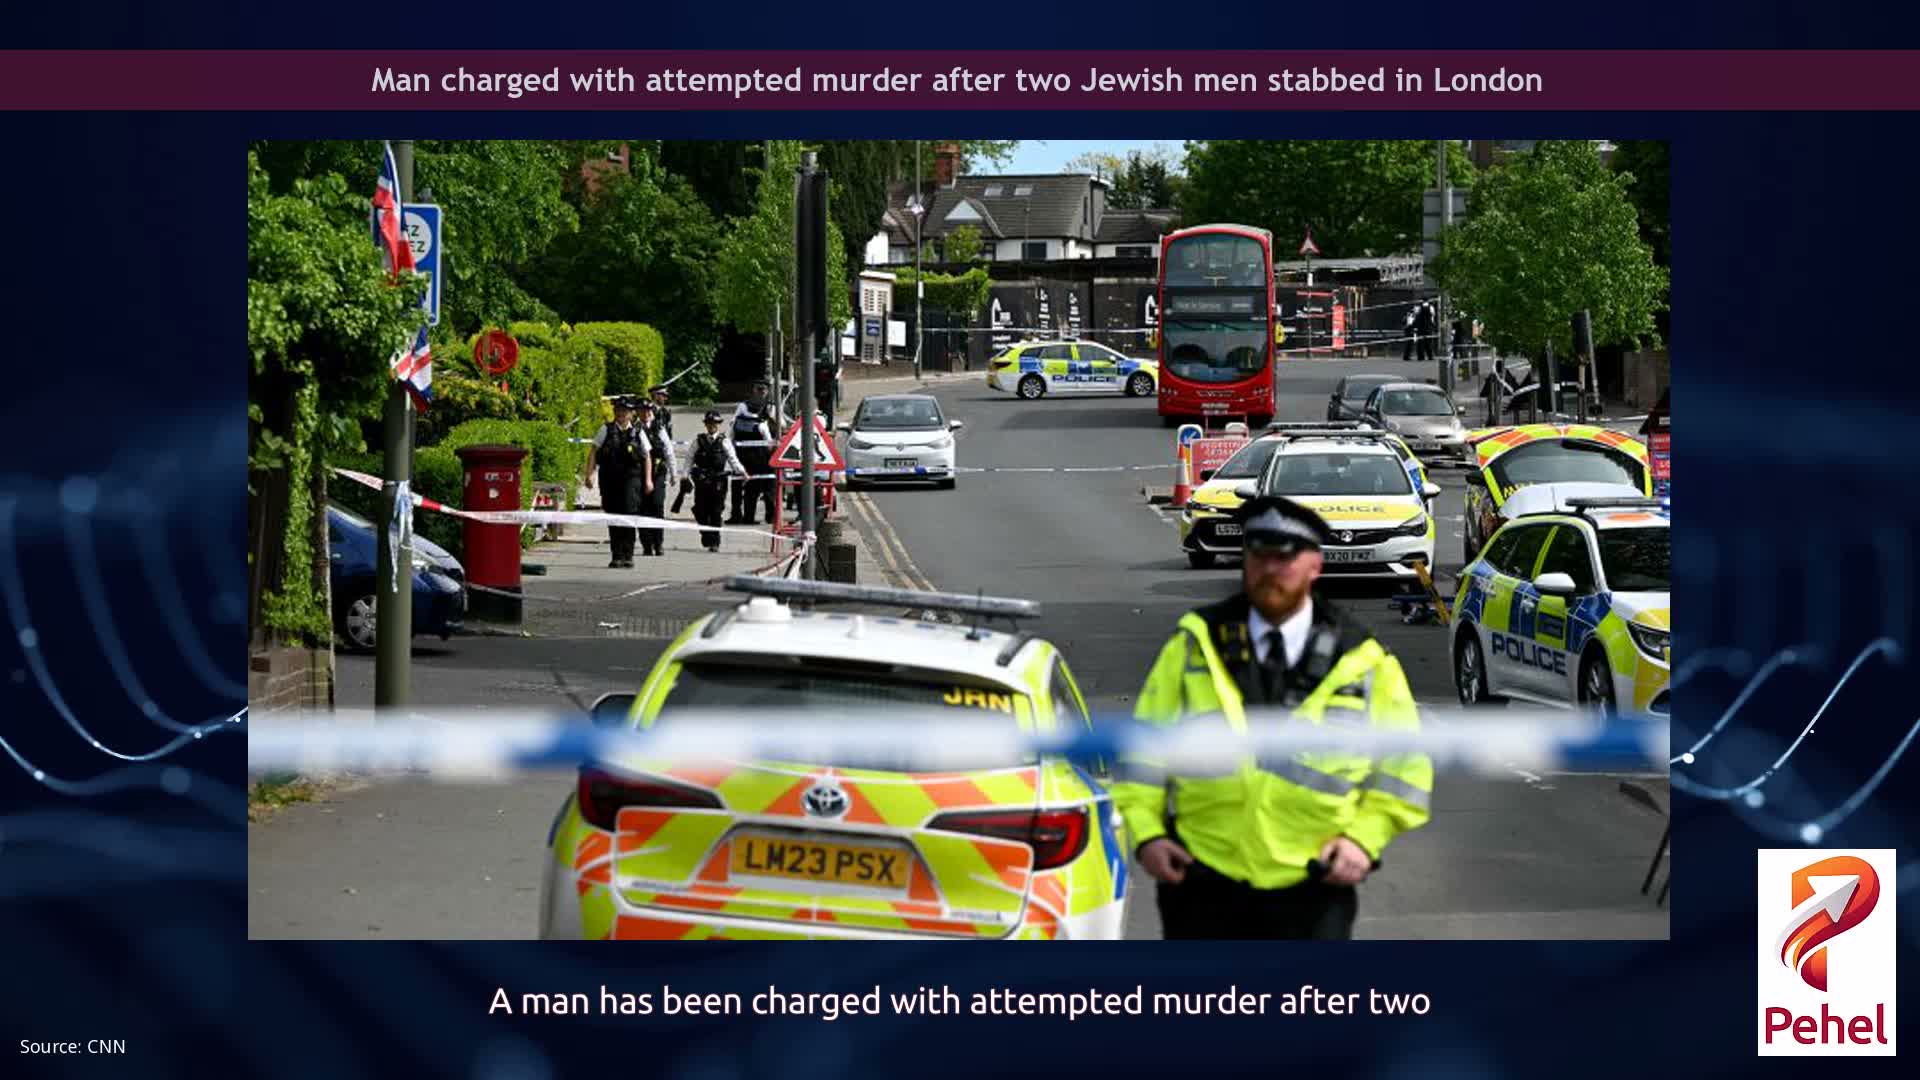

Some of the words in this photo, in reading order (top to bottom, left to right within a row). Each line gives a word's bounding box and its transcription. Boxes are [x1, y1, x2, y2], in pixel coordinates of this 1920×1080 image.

[1052, 375, 1117, 383] POLICE
[1491, 632, 1568, 677] POLICE
[745, 839, 826, 875] LM23
[834, 850, 896, 882] PSX
